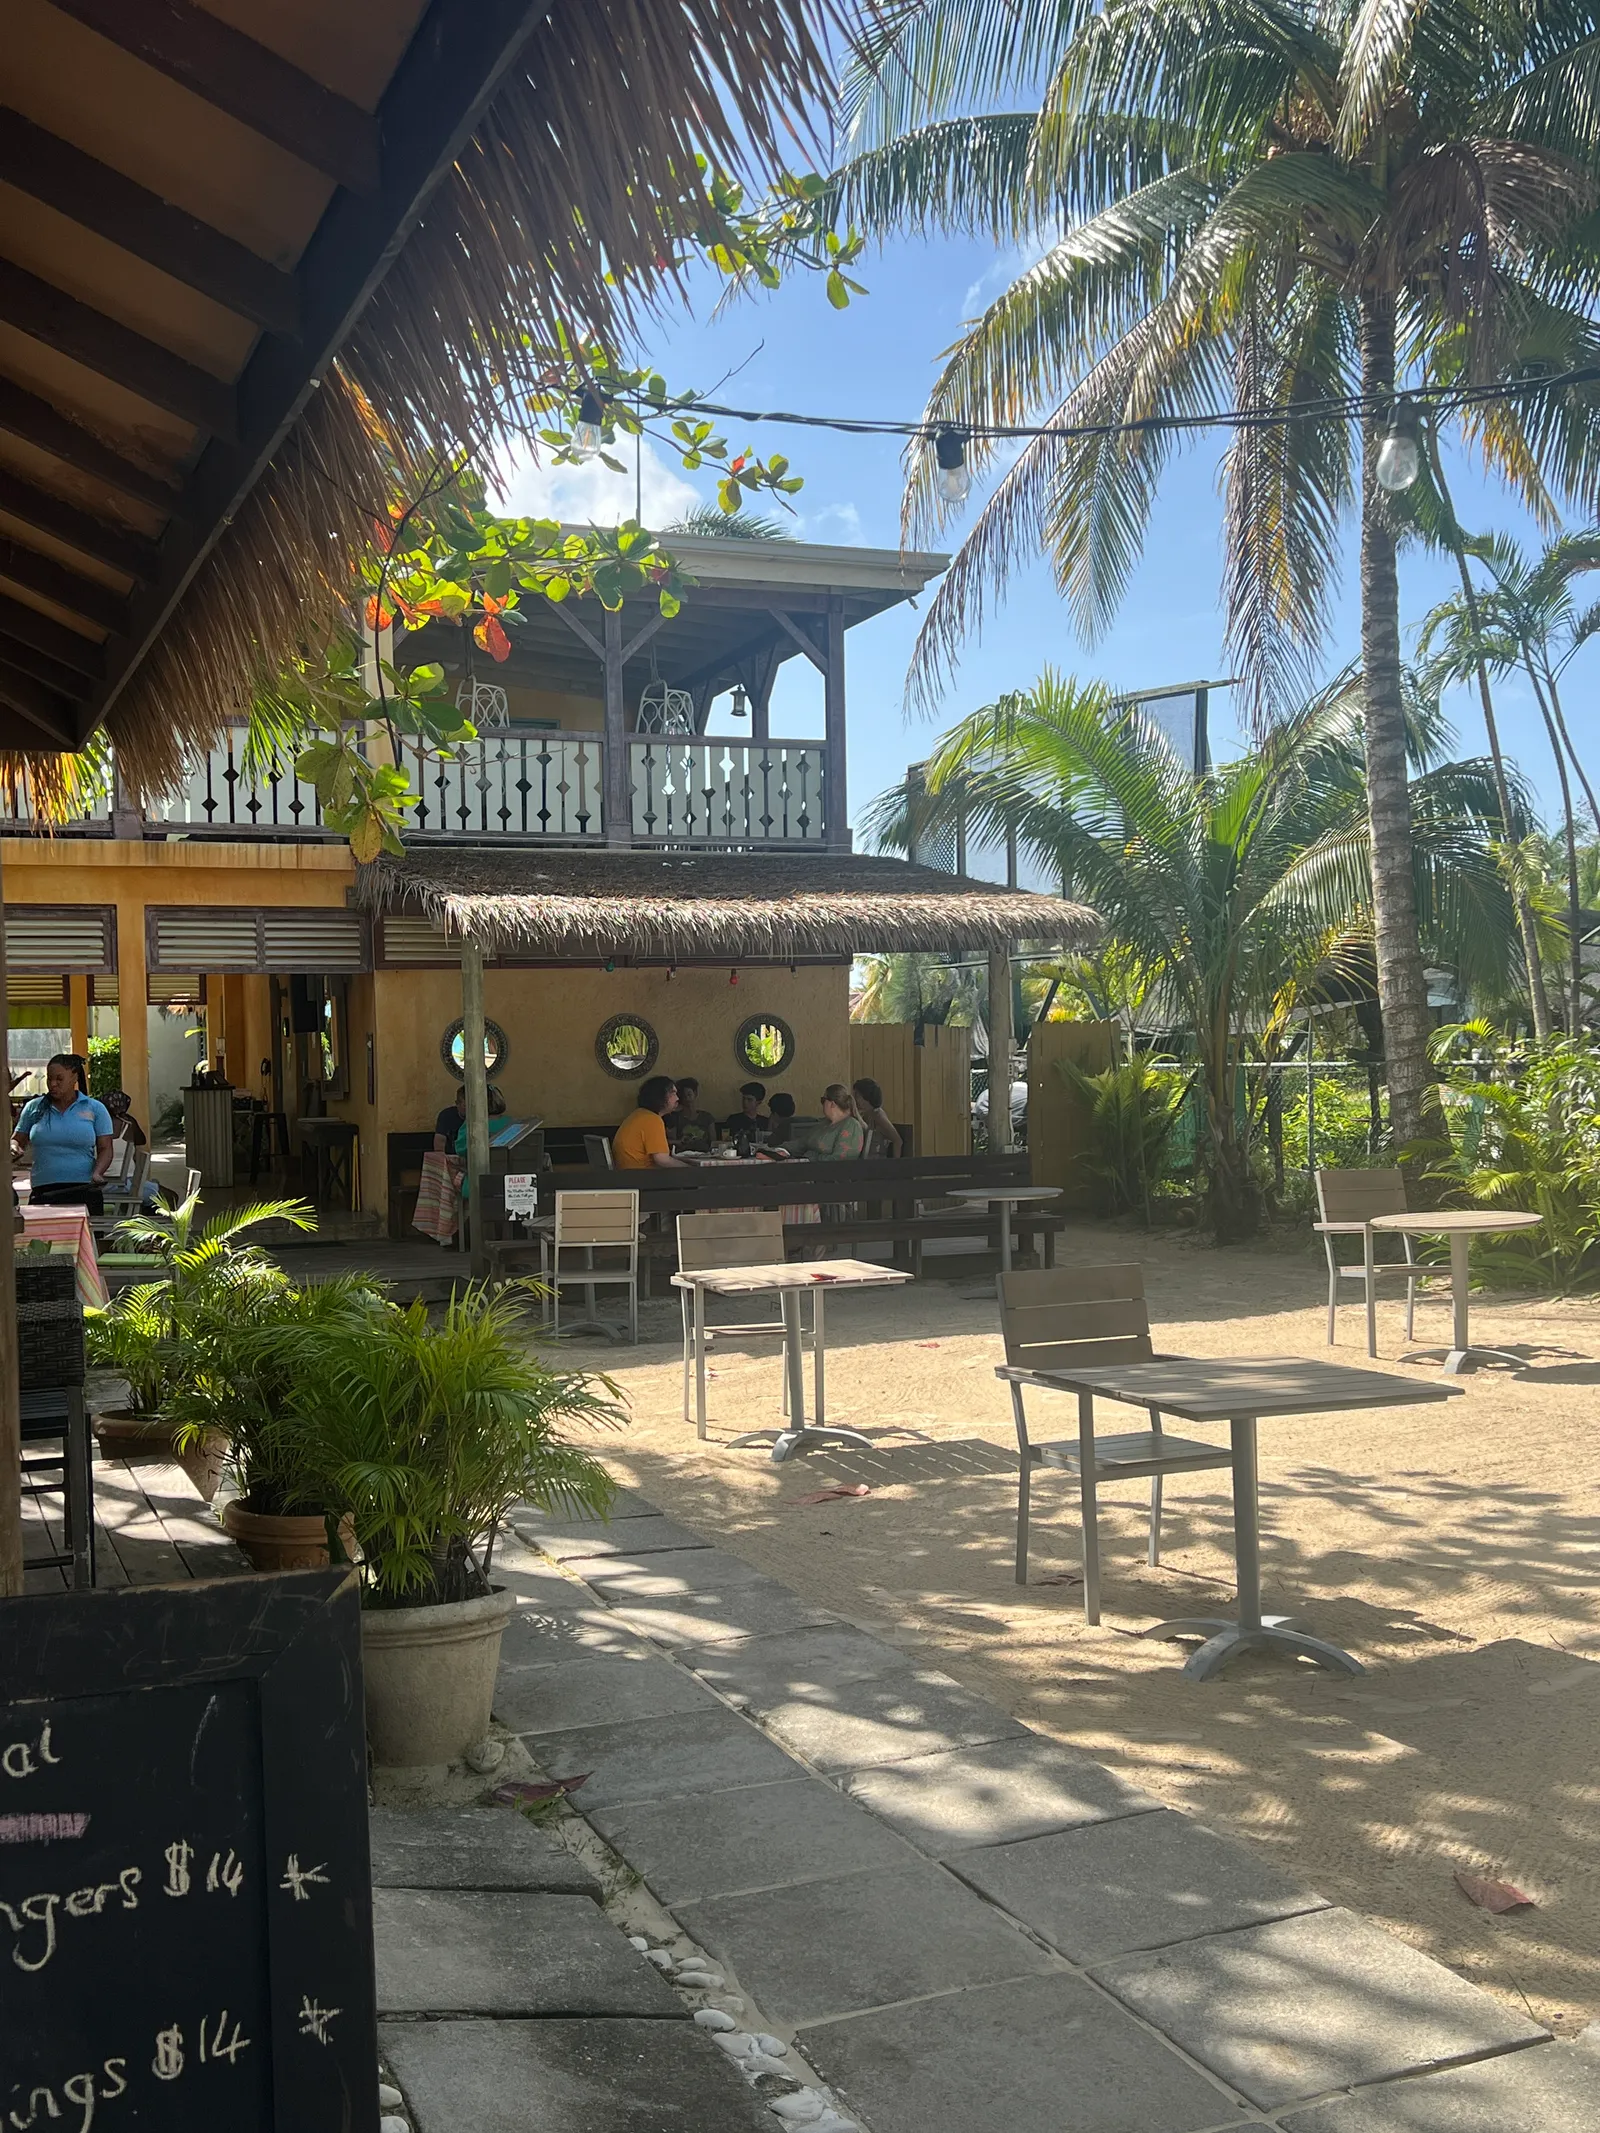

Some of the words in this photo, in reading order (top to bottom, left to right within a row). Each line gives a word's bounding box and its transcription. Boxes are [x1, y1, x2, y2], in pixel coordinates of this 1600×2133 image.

[508, 1176, 526, 1184] PLEASE
[163, 1838, 244, 1898] $14
[151, 2009, 251, 2081] $14
